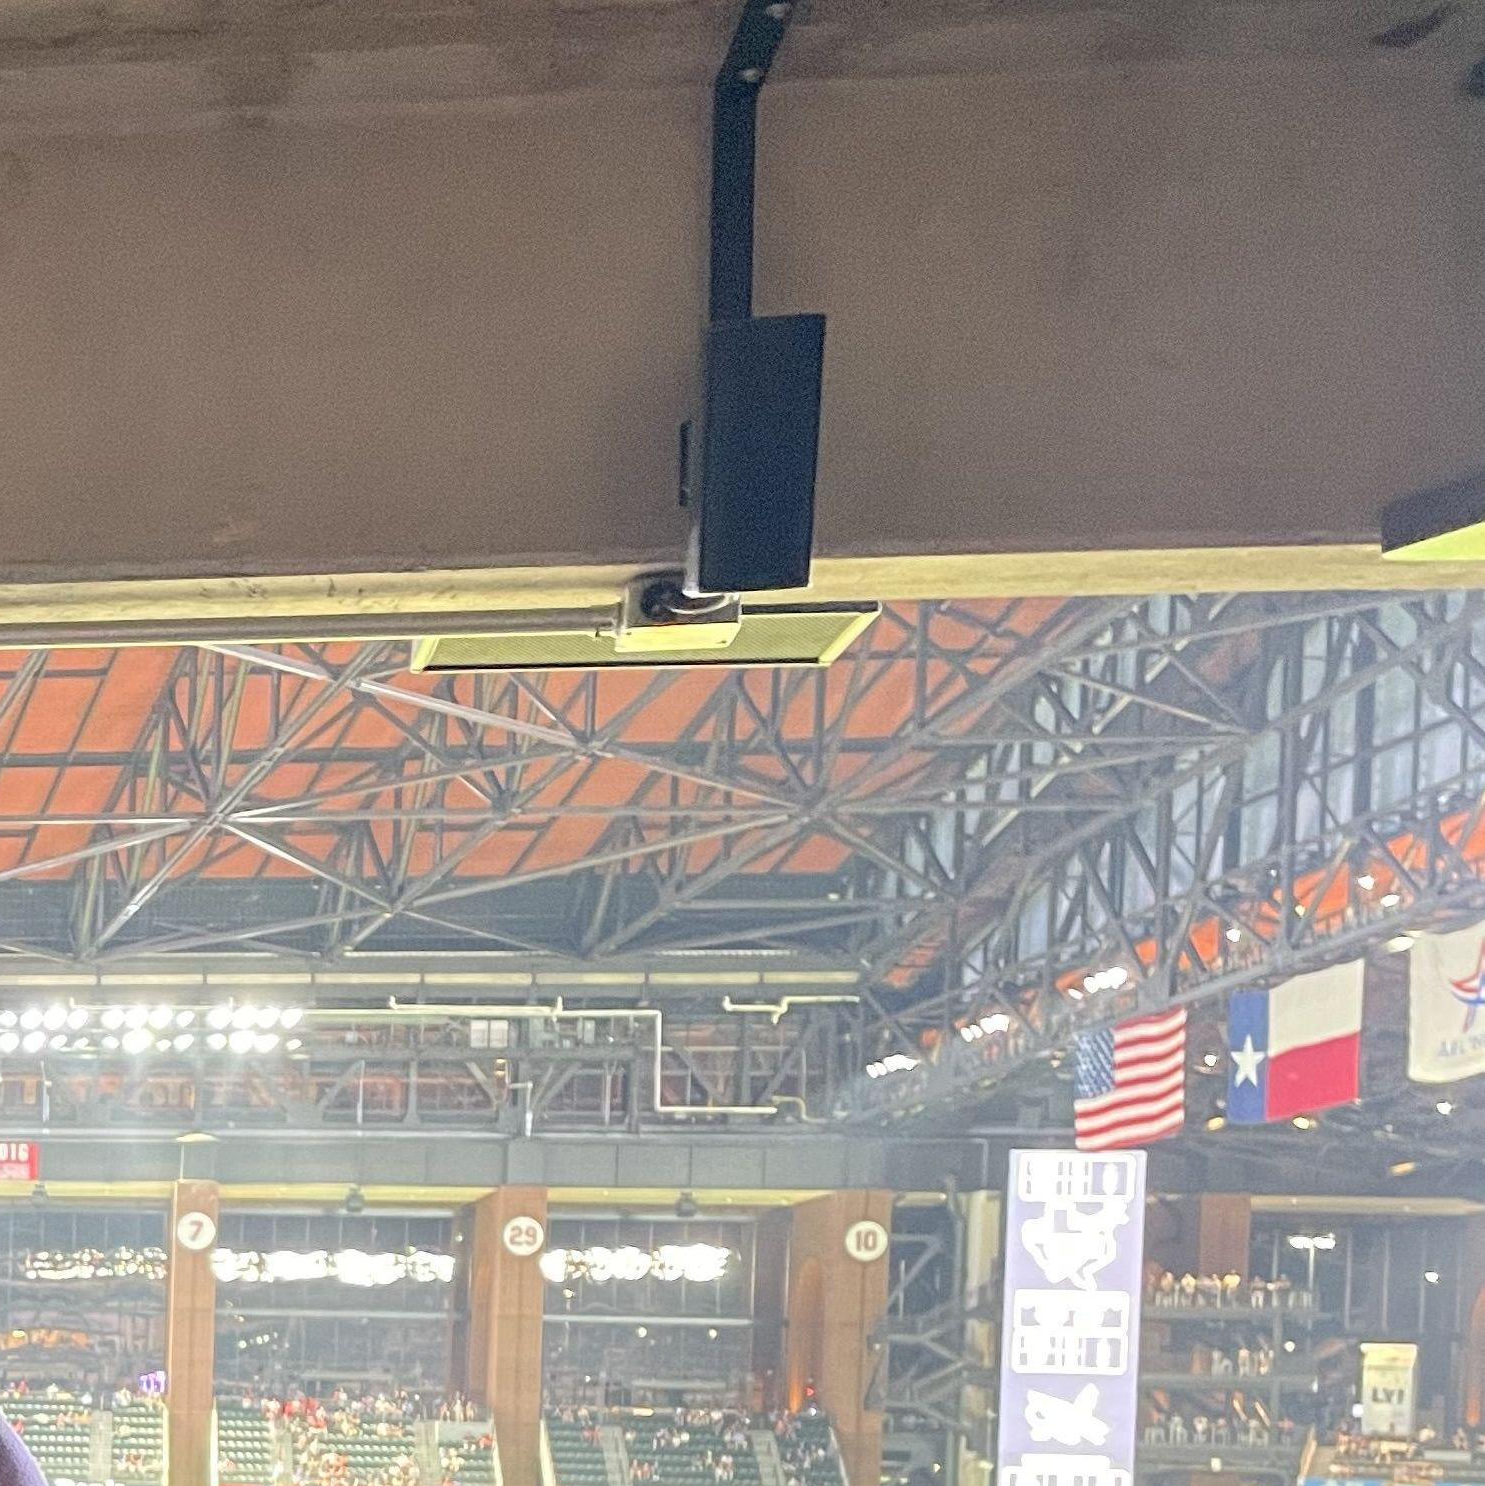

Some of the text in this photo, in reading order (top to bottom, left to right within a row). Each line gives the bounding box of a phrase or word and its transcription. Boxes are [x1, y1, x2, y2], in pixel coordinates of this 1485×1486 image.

[189, 1220, 204, 1242] 7
[509, 1225, 537, 1247] 29
[855, 1230, 878, 1252] 10
